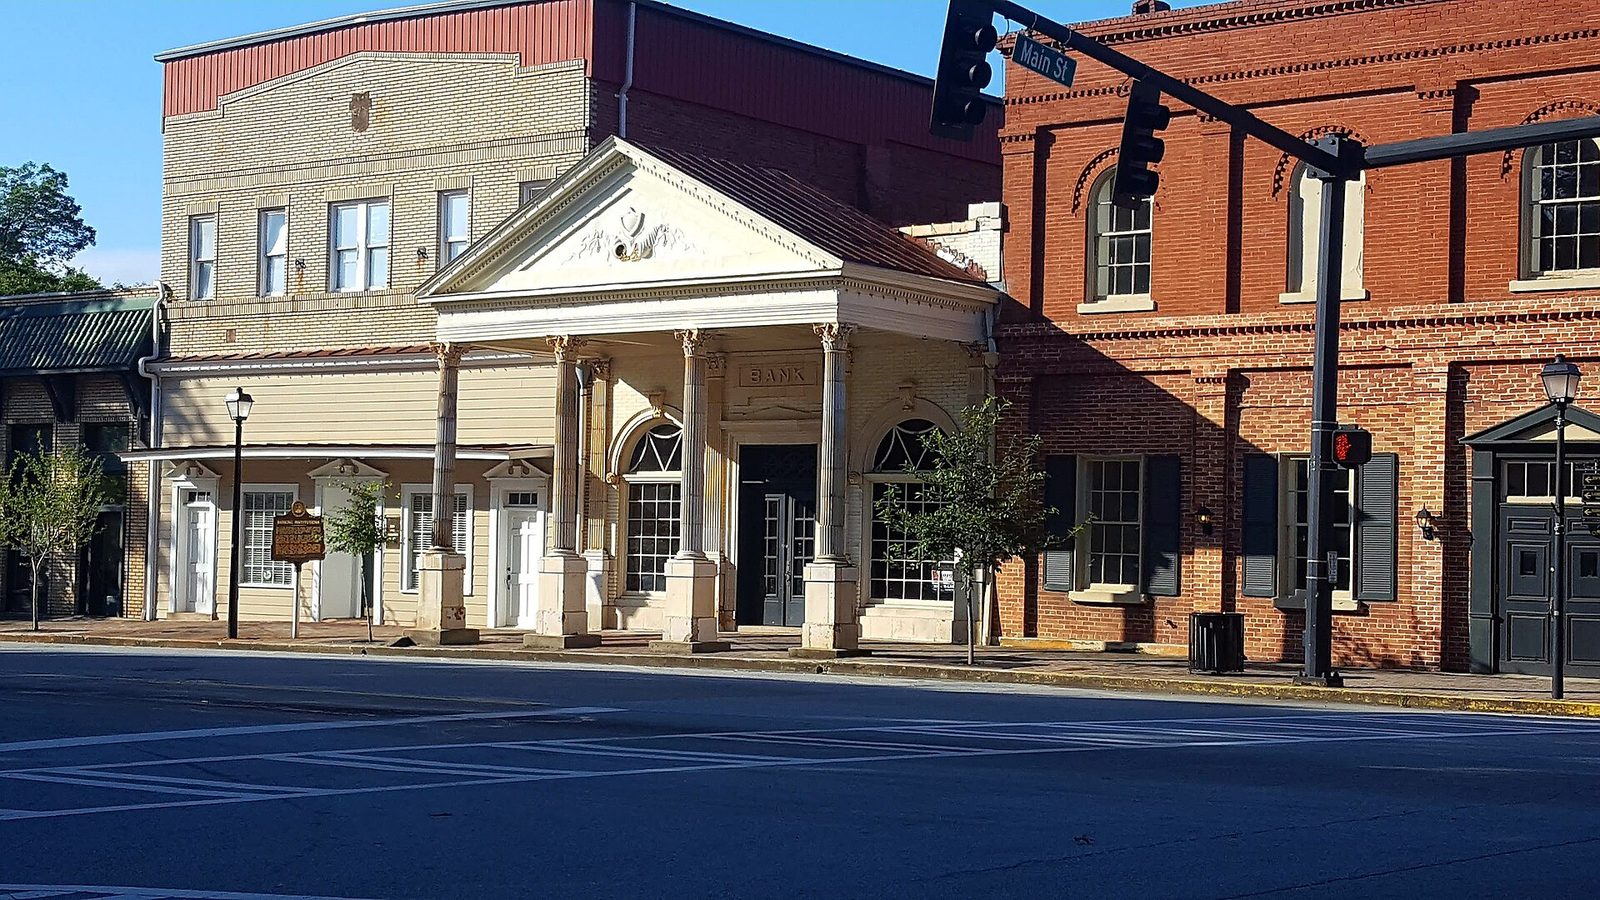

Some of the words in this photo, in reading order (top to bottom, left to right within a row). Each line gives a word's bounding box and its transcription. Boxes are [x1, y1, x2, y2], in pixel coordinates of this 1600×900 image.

[1020, 40, 1051, 73] Main
[1053, 57, 1068, 81] St
[750, 367, 805, 383] BANK
